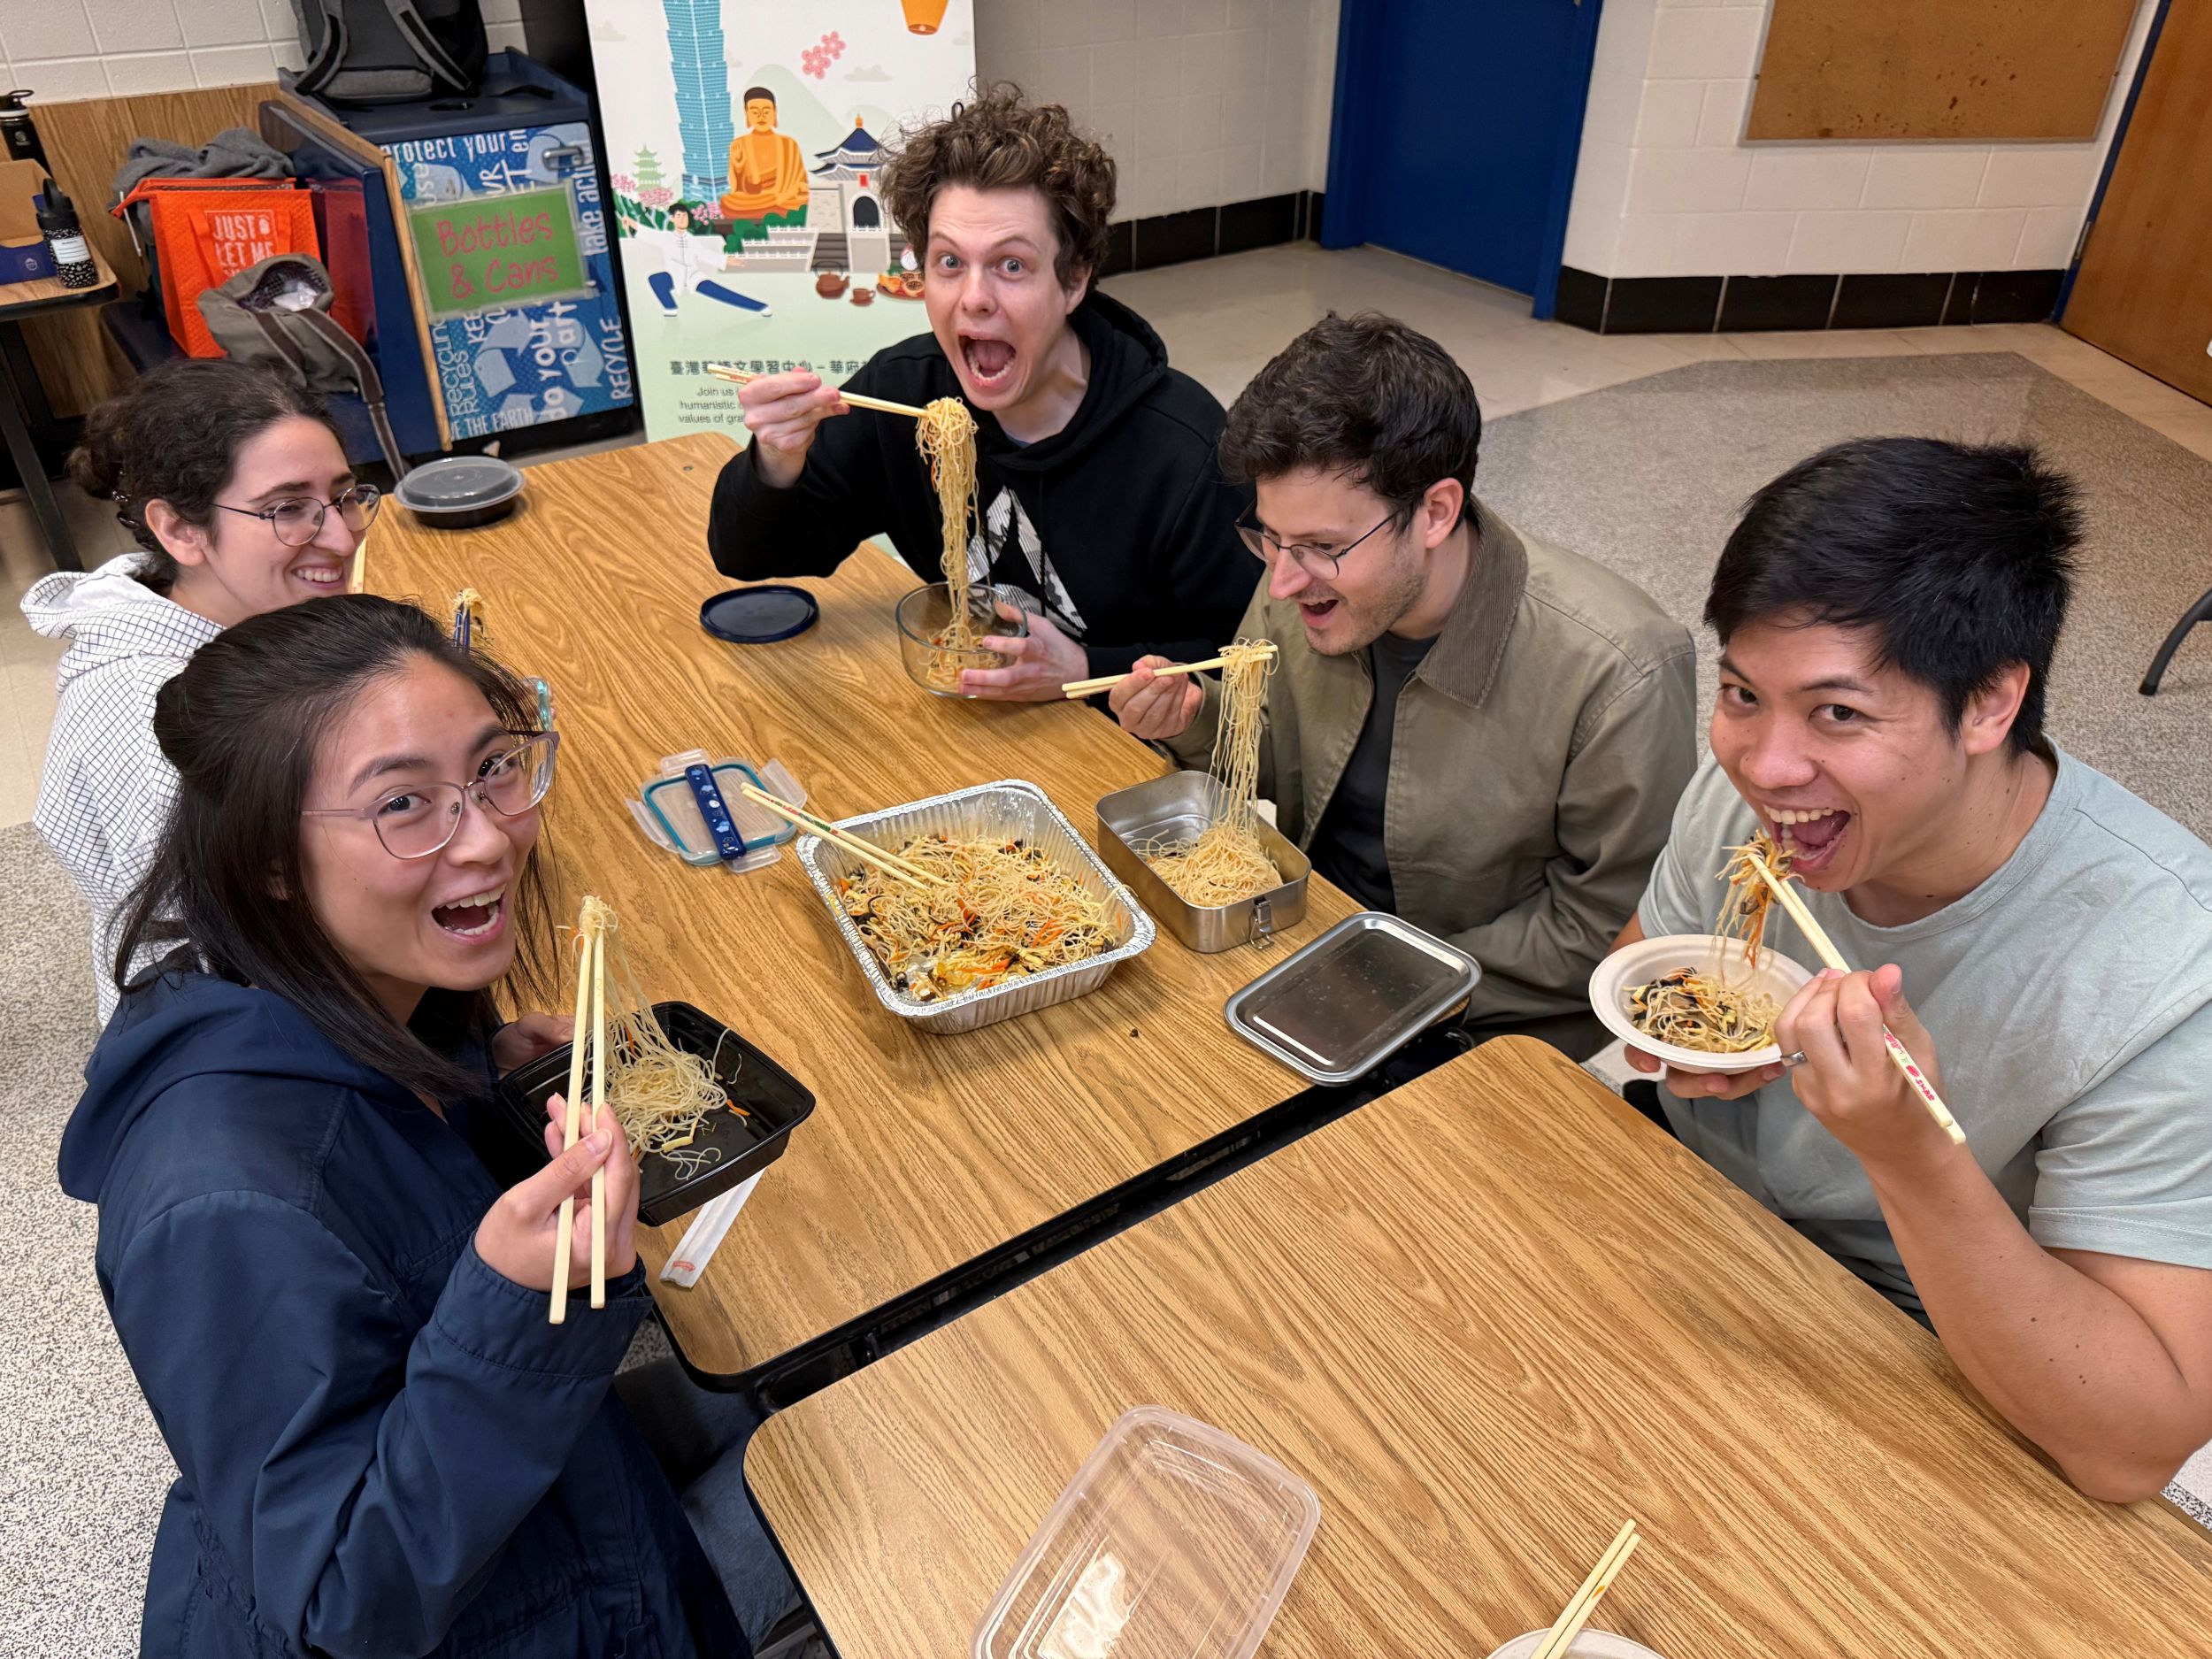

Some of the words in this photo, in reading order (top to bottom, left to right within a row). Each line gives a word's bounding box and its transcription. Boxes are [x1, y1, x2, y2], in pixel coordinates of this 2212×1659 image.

[463, 132, 507, 163] your
[213, 215, 256, 241] JUST
[436, 211, 554, 258] Bottles
[578, 210, 608, 256] take
[215, 242, 246, 267] LET
[450, 264, 474, 299] &
[486, 256, 559, 294] Cans
[464, 310, 488, 344] KEE
[680, 401, 736, 410] humanistic
[696, 387, 719, 396] Join
[464, 414, 489, 438] THE
[492, 407, 534, 433] EARTH
[679, 414, 711, 424] values
[713, 413, 724, 424] of
